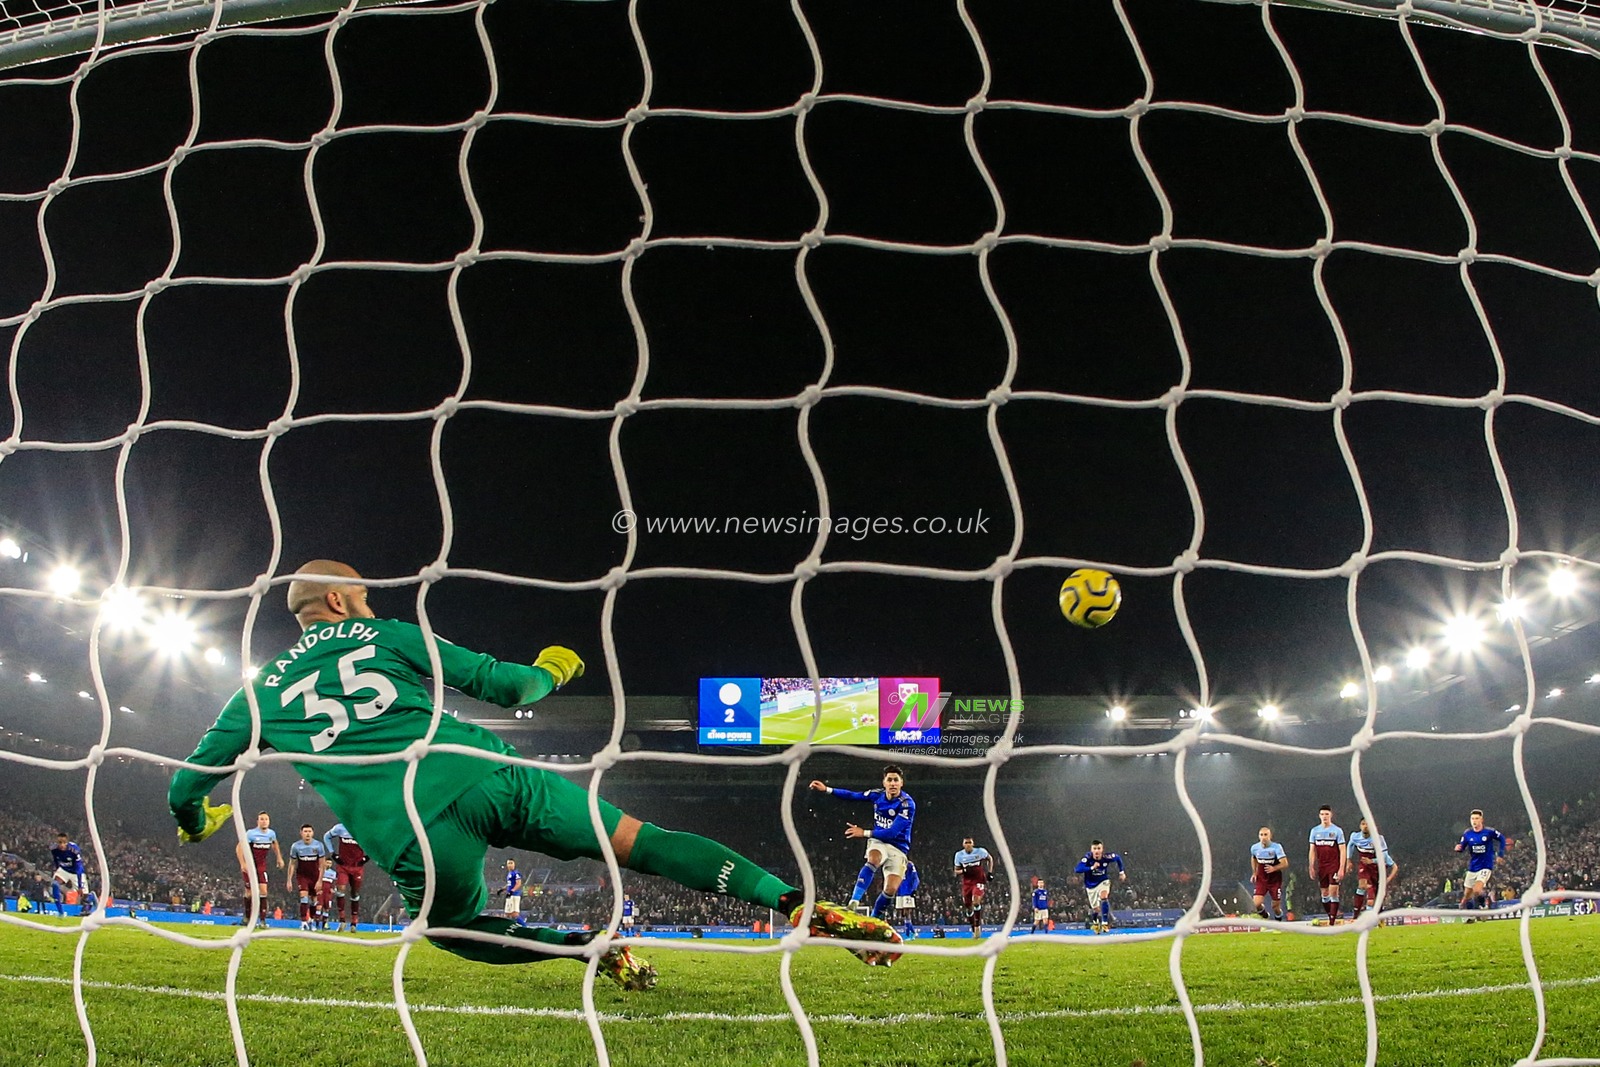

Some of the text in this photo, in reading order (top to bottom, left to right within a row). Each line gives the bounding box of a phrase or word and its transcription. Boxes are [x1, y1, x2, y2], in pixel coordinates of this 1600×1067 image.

[265, 622, 379, 687] RANDOLPH
[281, 644, 399, 752] 35
[724, 708, 736, 723] 2
[717, 859, 735, 893] WHU
